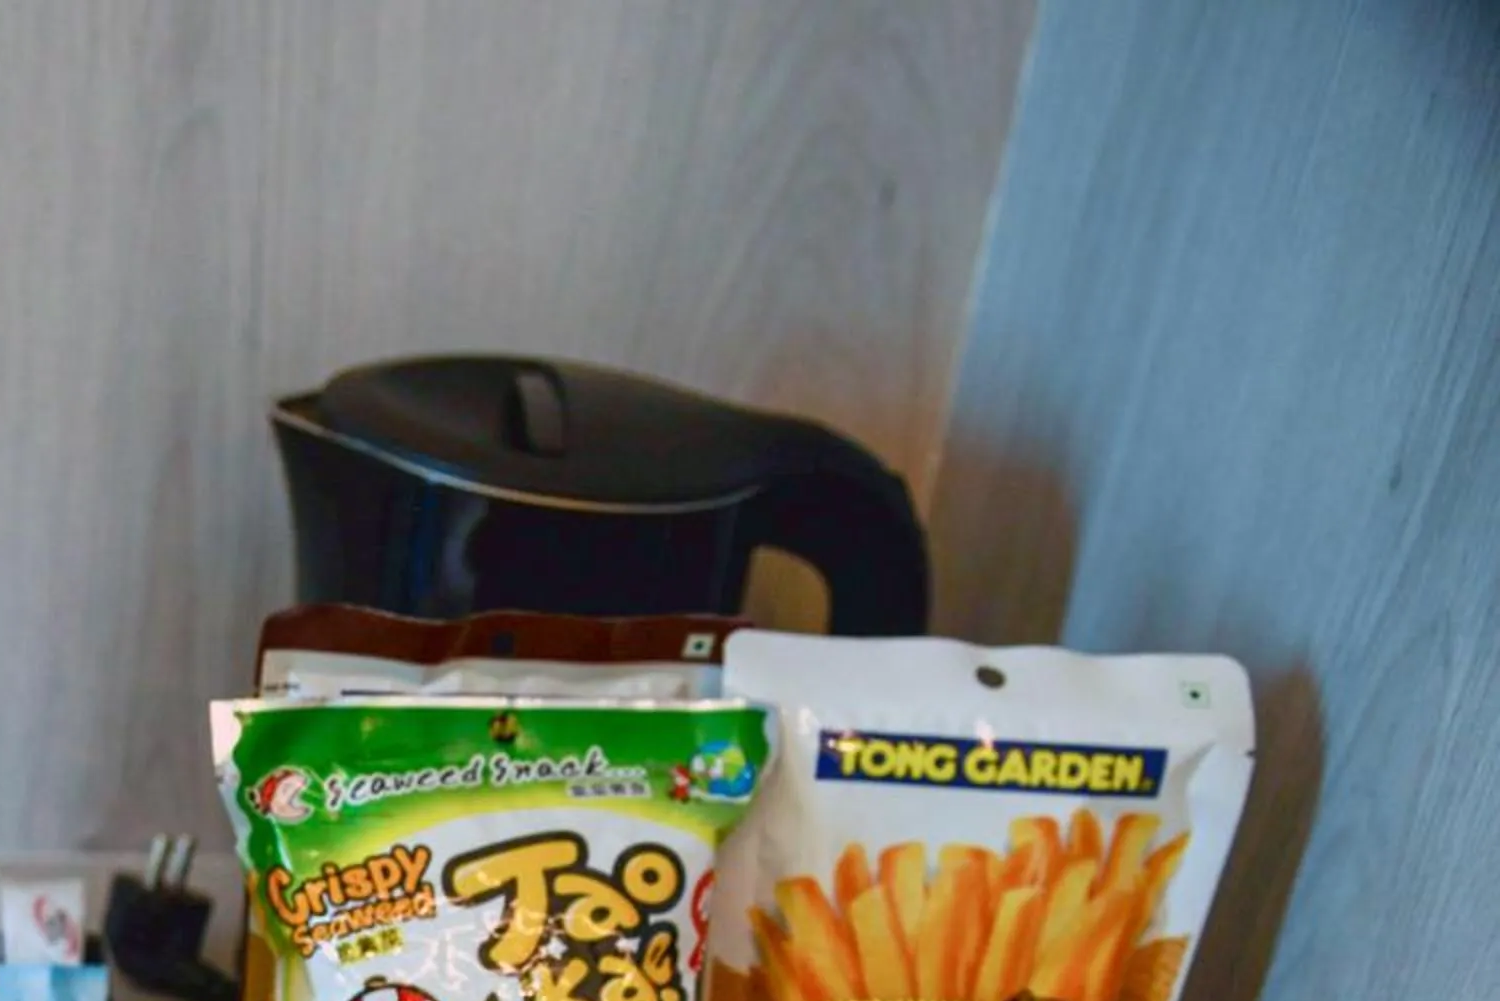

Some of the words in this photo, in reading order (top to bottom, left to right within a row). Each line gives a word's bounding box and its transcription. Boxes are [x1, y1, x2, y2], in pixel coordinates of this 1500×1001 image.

[327, 754, 481, 807] Seaweed
[836, 737, 958, 783] TONG
[962, 746, 1146, 793] GARDEN
[267, 844, 432, 927] Crispy
[447, 834, 682, 973] Tao
